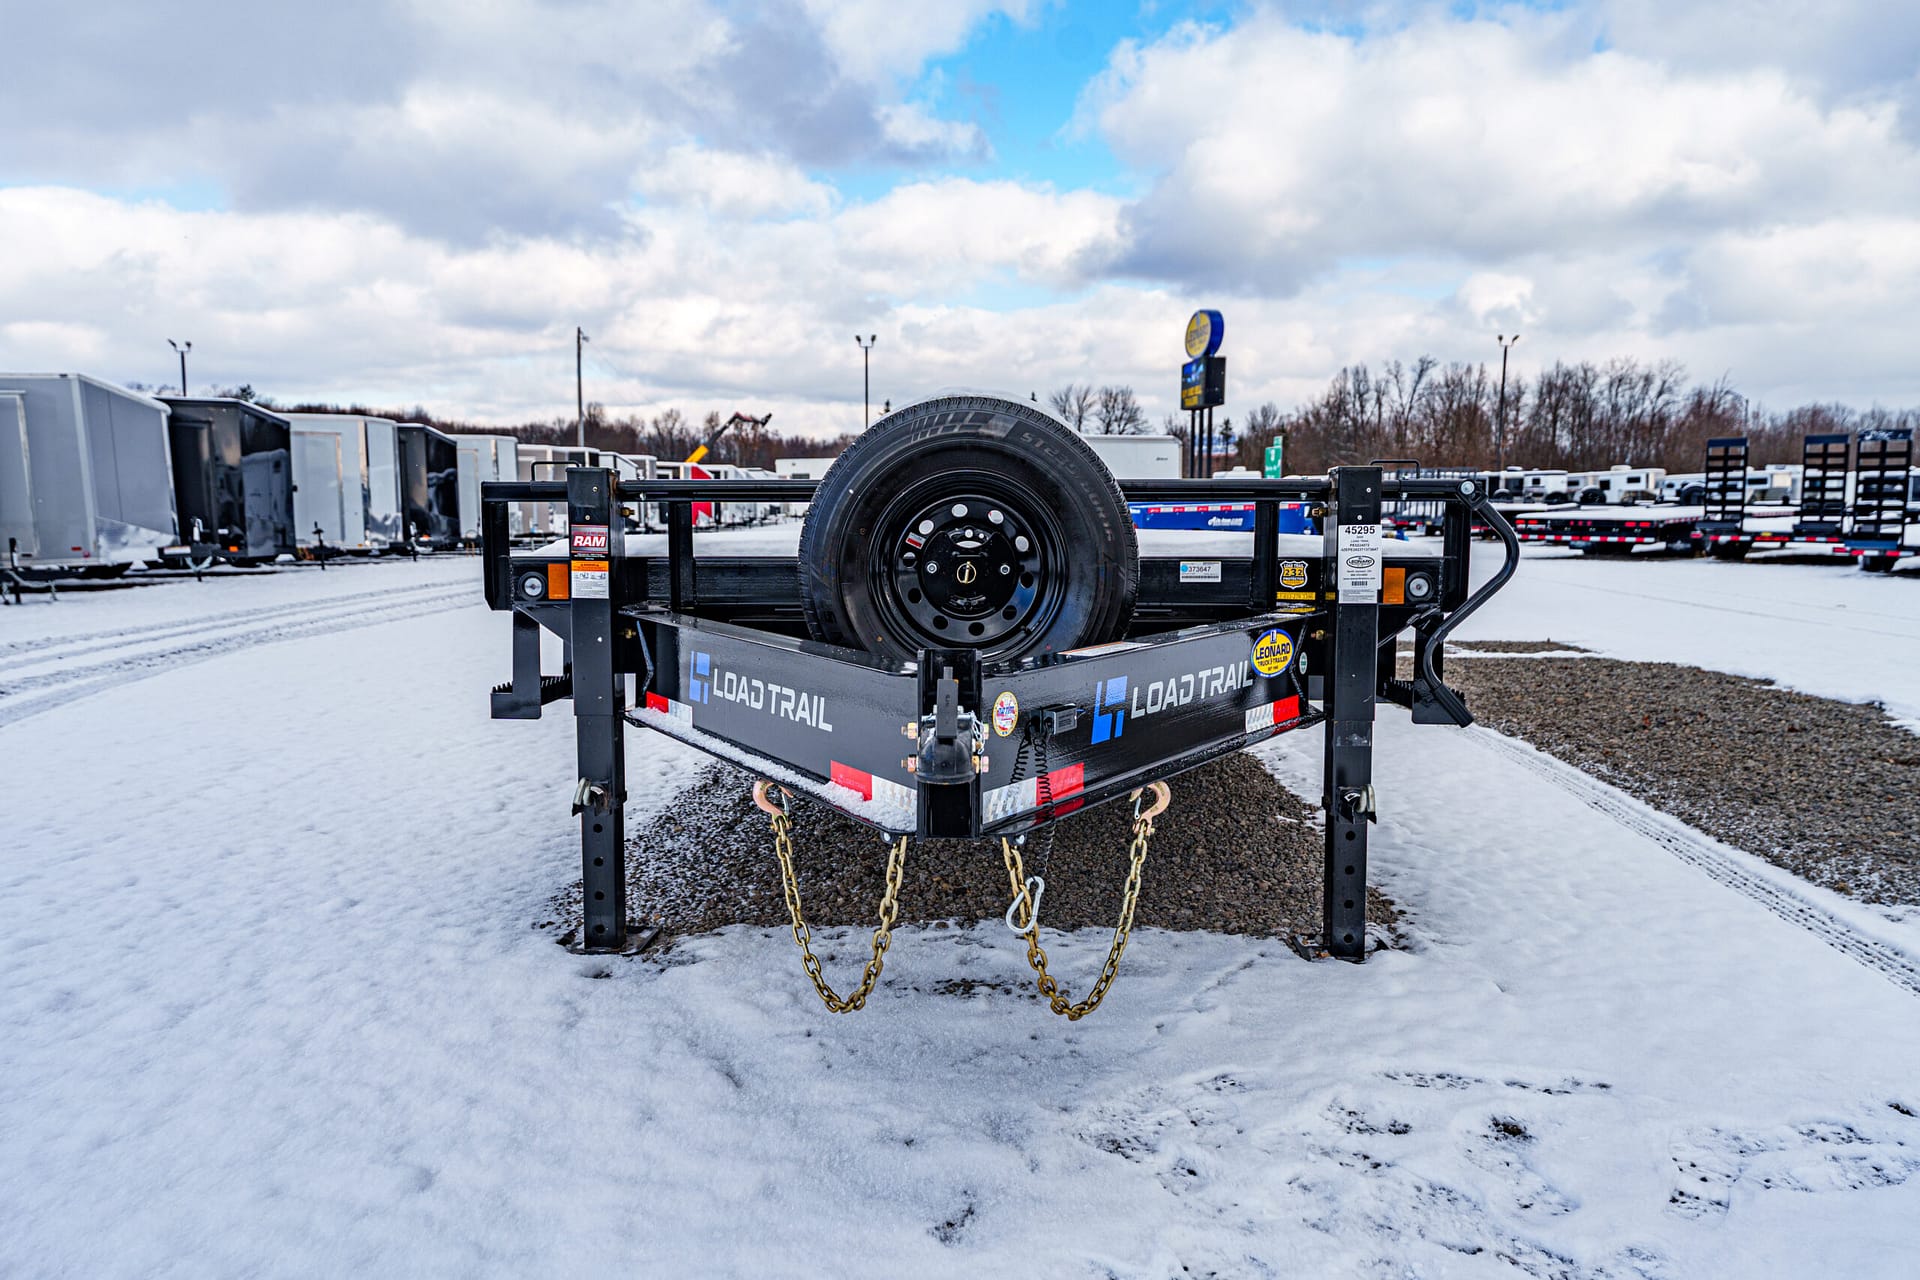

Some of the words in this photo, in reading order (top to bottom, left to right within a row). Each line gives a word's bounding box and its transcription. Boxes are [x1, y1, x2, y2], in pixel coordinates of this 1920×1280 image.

[1344, 525, 1375, 535] 45295
[573, 535, 606, 547] RAM
[1256, 642, 1290, 661] LEONARD
[1131, 674, 1195, 719] LOAD
[1199, 660, 1253, 699] TRAIL
[713, 668, 764, 710] LOAD
[767, 683, 833, 732] TRAIL
